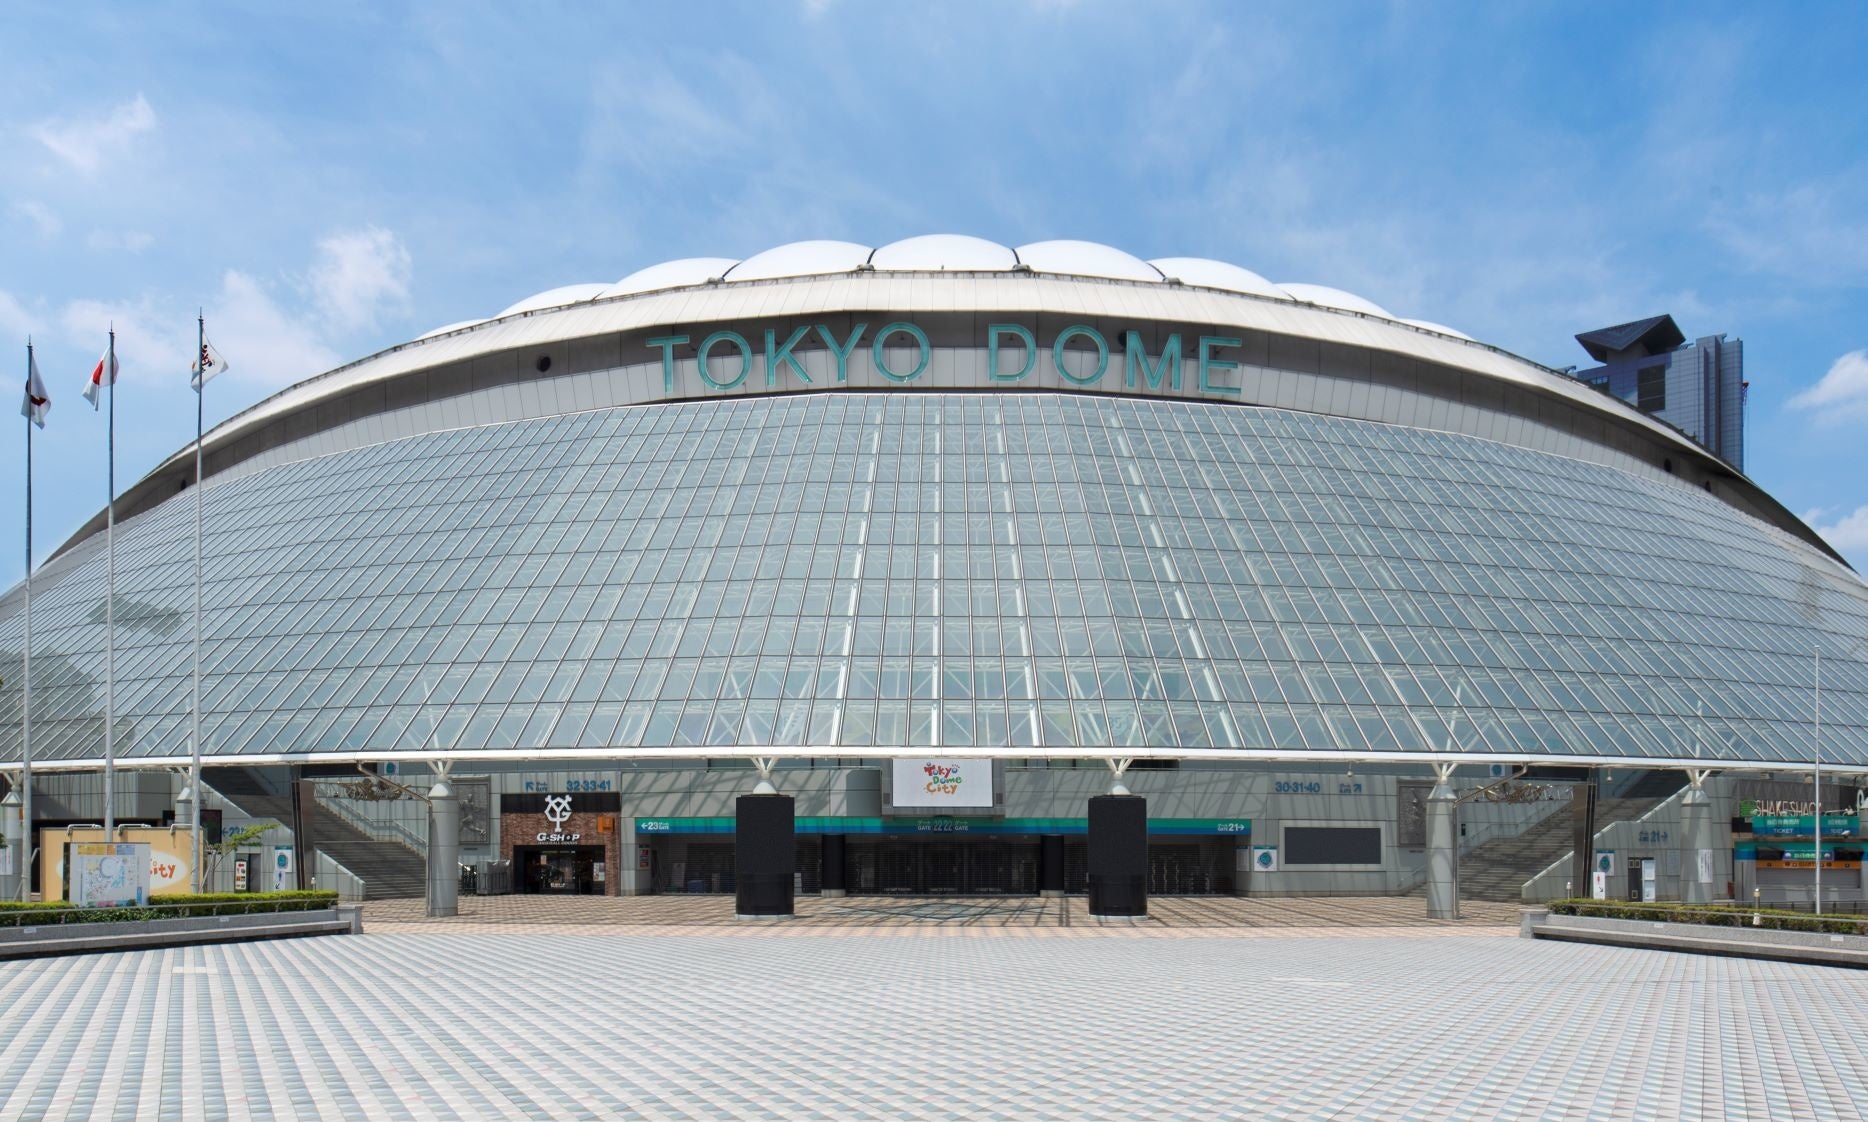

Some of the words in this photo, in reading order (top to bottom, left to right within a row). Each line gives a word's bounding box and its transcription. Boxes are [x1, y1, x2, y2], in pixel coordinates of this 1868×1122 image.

[646, 322, 930, 392] TOKYO
[987, 323, 1242, 394] DOME
[923, 762, 959, 778] Tokyo
[932, 775, 962, 785] Dome
[925, 782, 957, 795] City
[1756, 799, 1788, 816] SHAKE
[648, 822, 659, 830] 23
[1228, 823, 1239, 832] 21
[150, 861, 176, 879] ity
